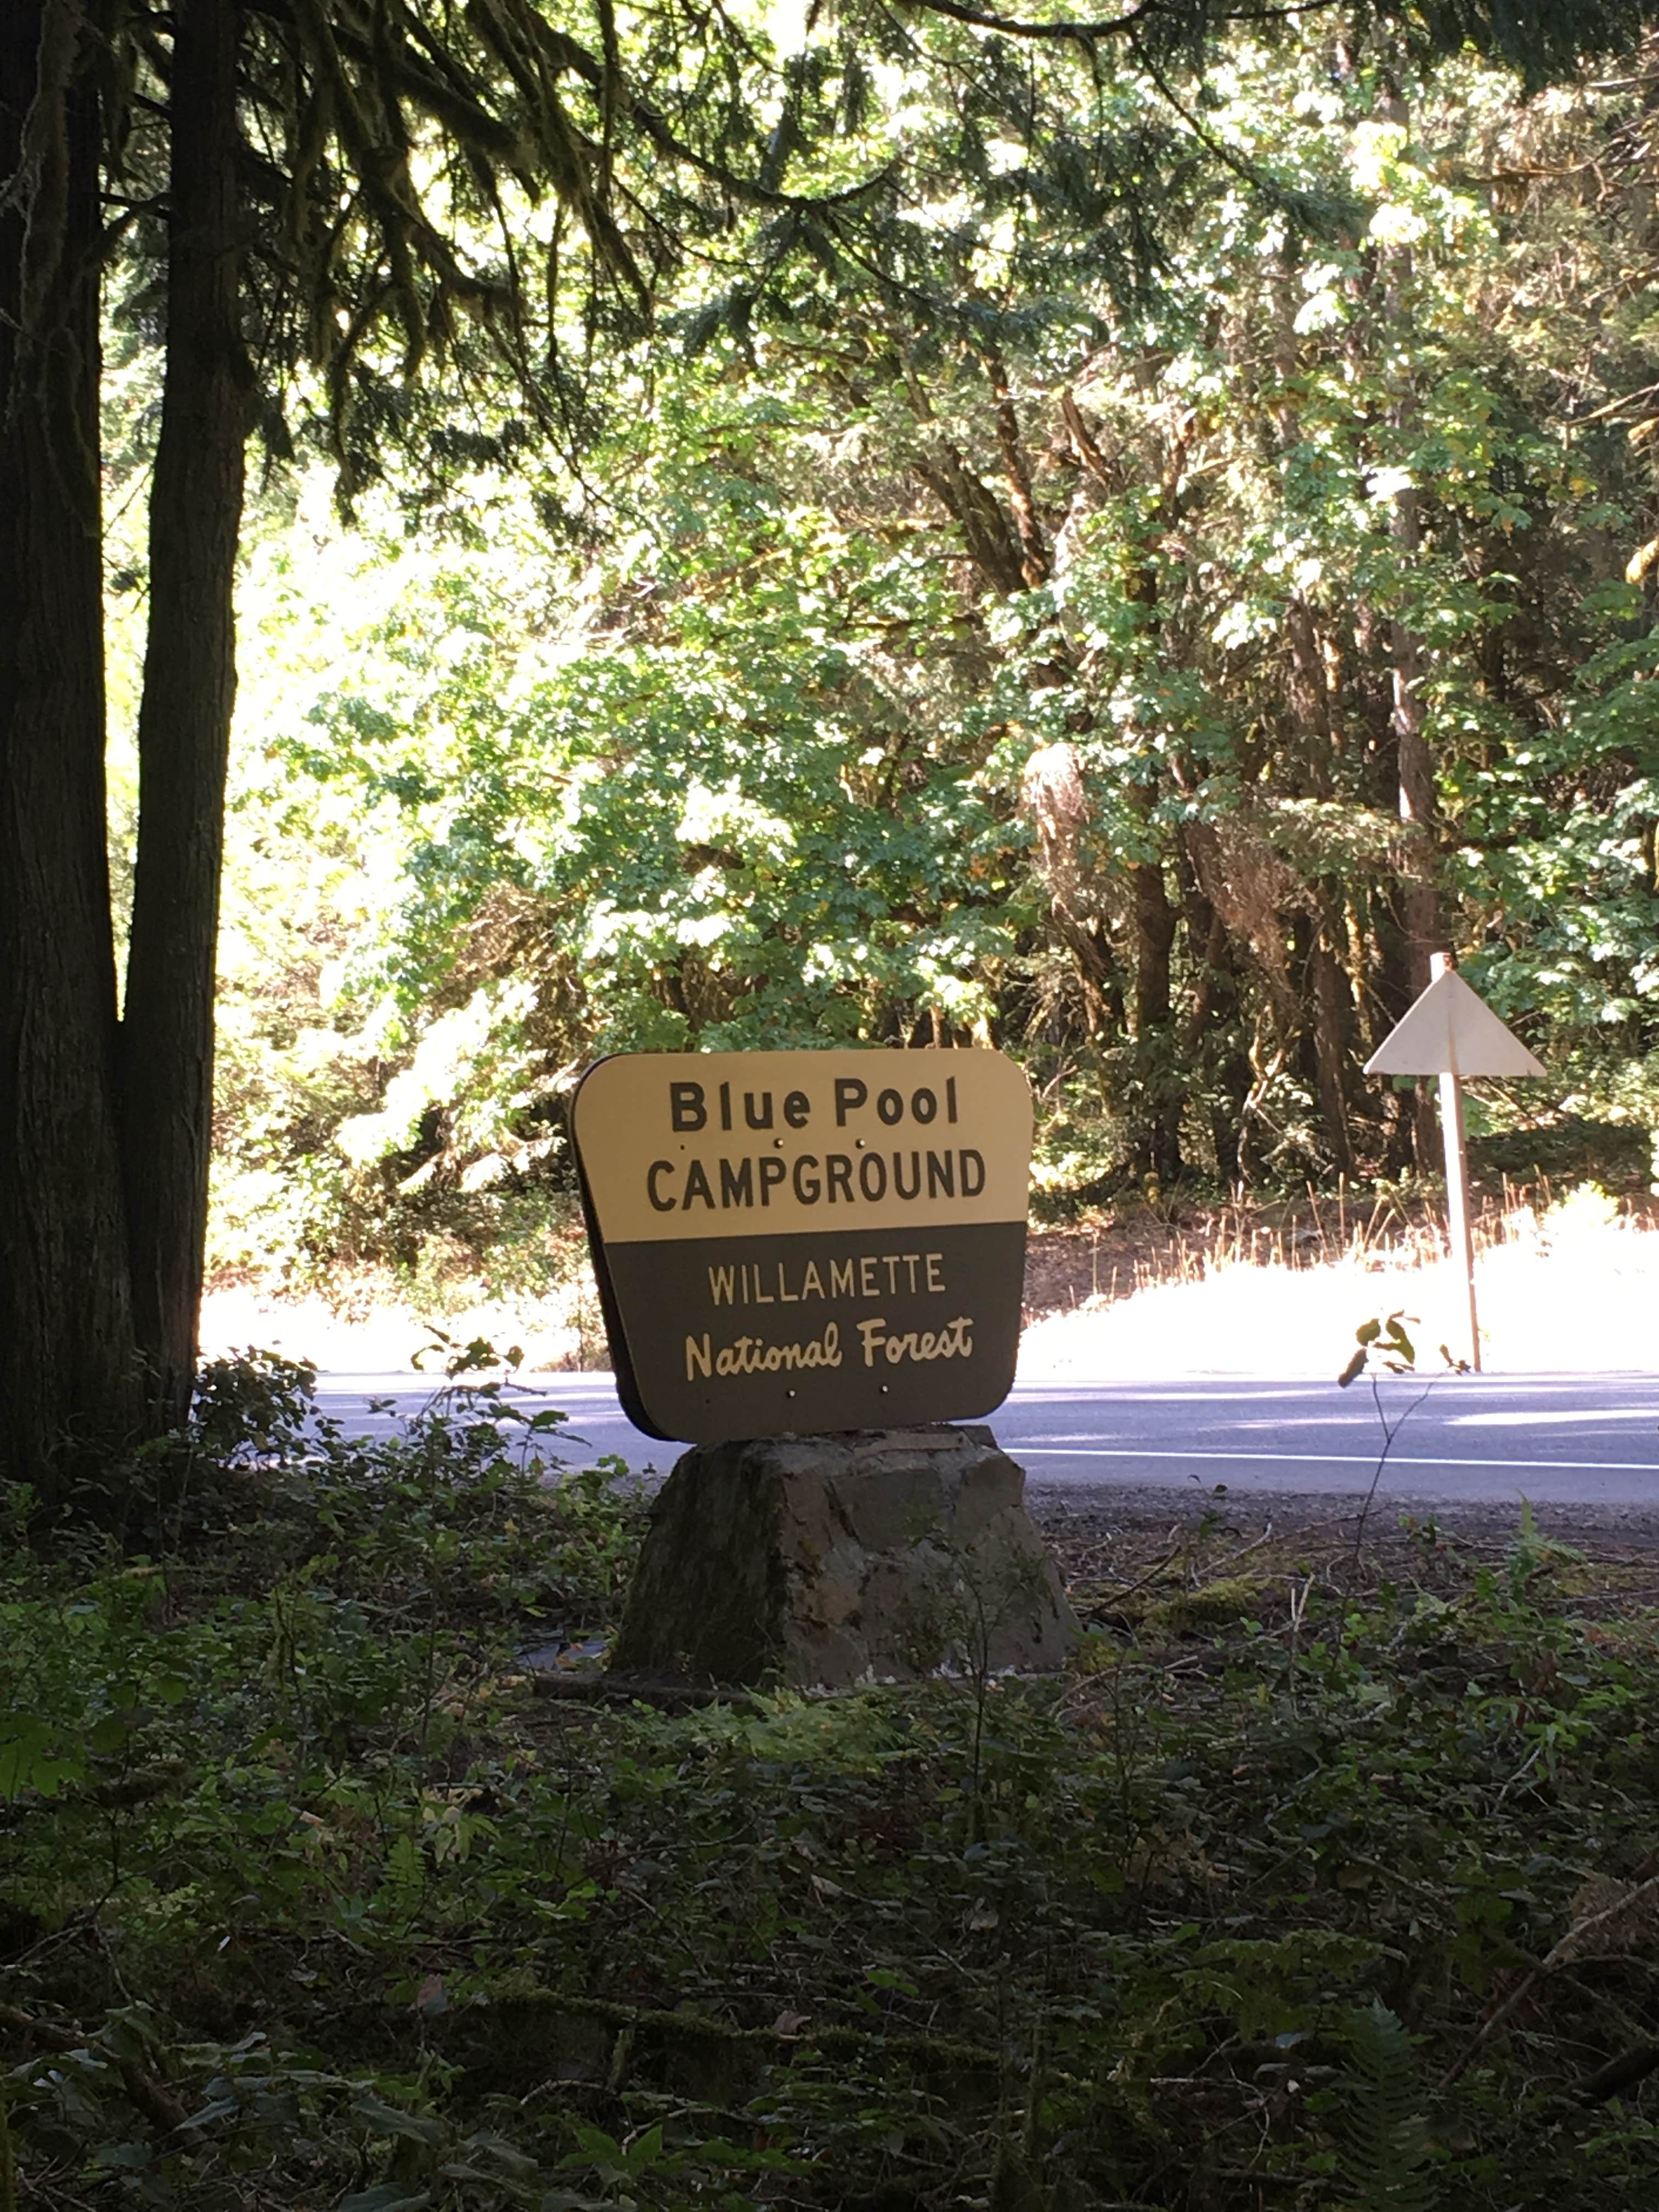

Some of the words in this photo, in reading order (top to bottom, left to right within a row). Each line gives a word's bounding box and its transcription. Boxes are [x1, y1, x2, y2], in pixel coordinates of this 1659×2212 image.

[670, 1081, 810, 1132] Blue
[834, 1076, 957, 1127] Pool
[647, 1149, 986, 1211] CAMPGROUND
[708, 1253, 946, 1305] WILLAMETTE
[686, 1322, 842, 1381] National
[857, 1317, 974, 1368] Forest
